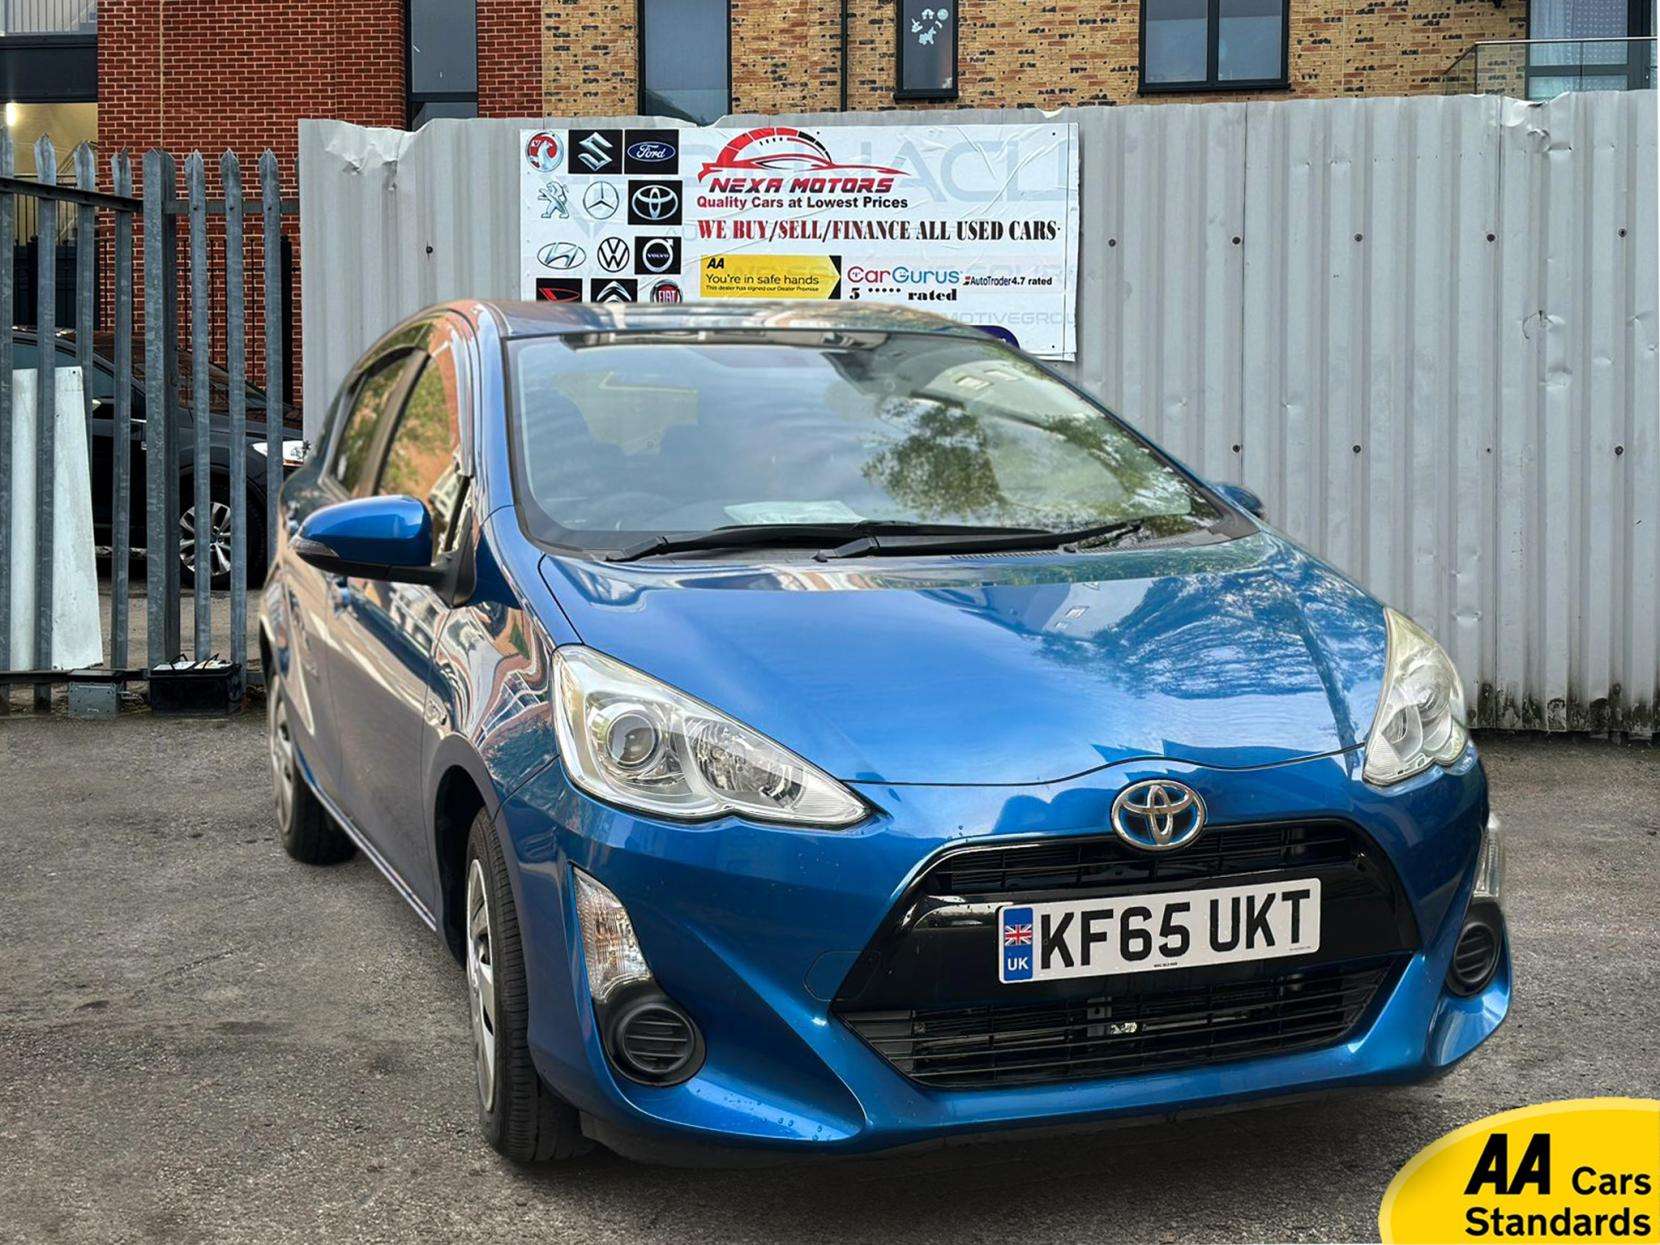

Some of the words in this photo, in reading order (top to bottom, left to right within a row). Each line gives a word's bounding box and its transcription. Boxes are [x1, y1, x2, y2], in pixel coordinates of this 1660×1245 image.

[636, 144, 666, 158] Ford
[709, 178, 783, 193] NEXA
[789, 178, 894, 193] MOTORS
[697, 196, 746, 210] Quality
[752, 196, 784, 209] Cars
[788, 197, 802, 208] at
[807, 196, 858, 208] Lowest
[863, 196, 908, 208] Prices
[697, 220, 727, 240] WE
[916, 221, 951, 240] ALL
[956, 220, 1003, 241] USED
[706, 258, 724, 269] AA
[706, 274, 741, 284] You're
[744, 274, 754, 283] in
[757, 274, 780, 284] safe
[784, 275, 819, 285] hands
[847, 266, 960, 283] CarGurus
[1028, 277, 1052, 285] rated
[849, 288, 860, 300] 5
[908, 288, 957, 300] rated
[1040, 901, 1191, 970] KF65
[1209, 888, 1311, 953] UKT
[1008, 957, 1029, 970] UK
